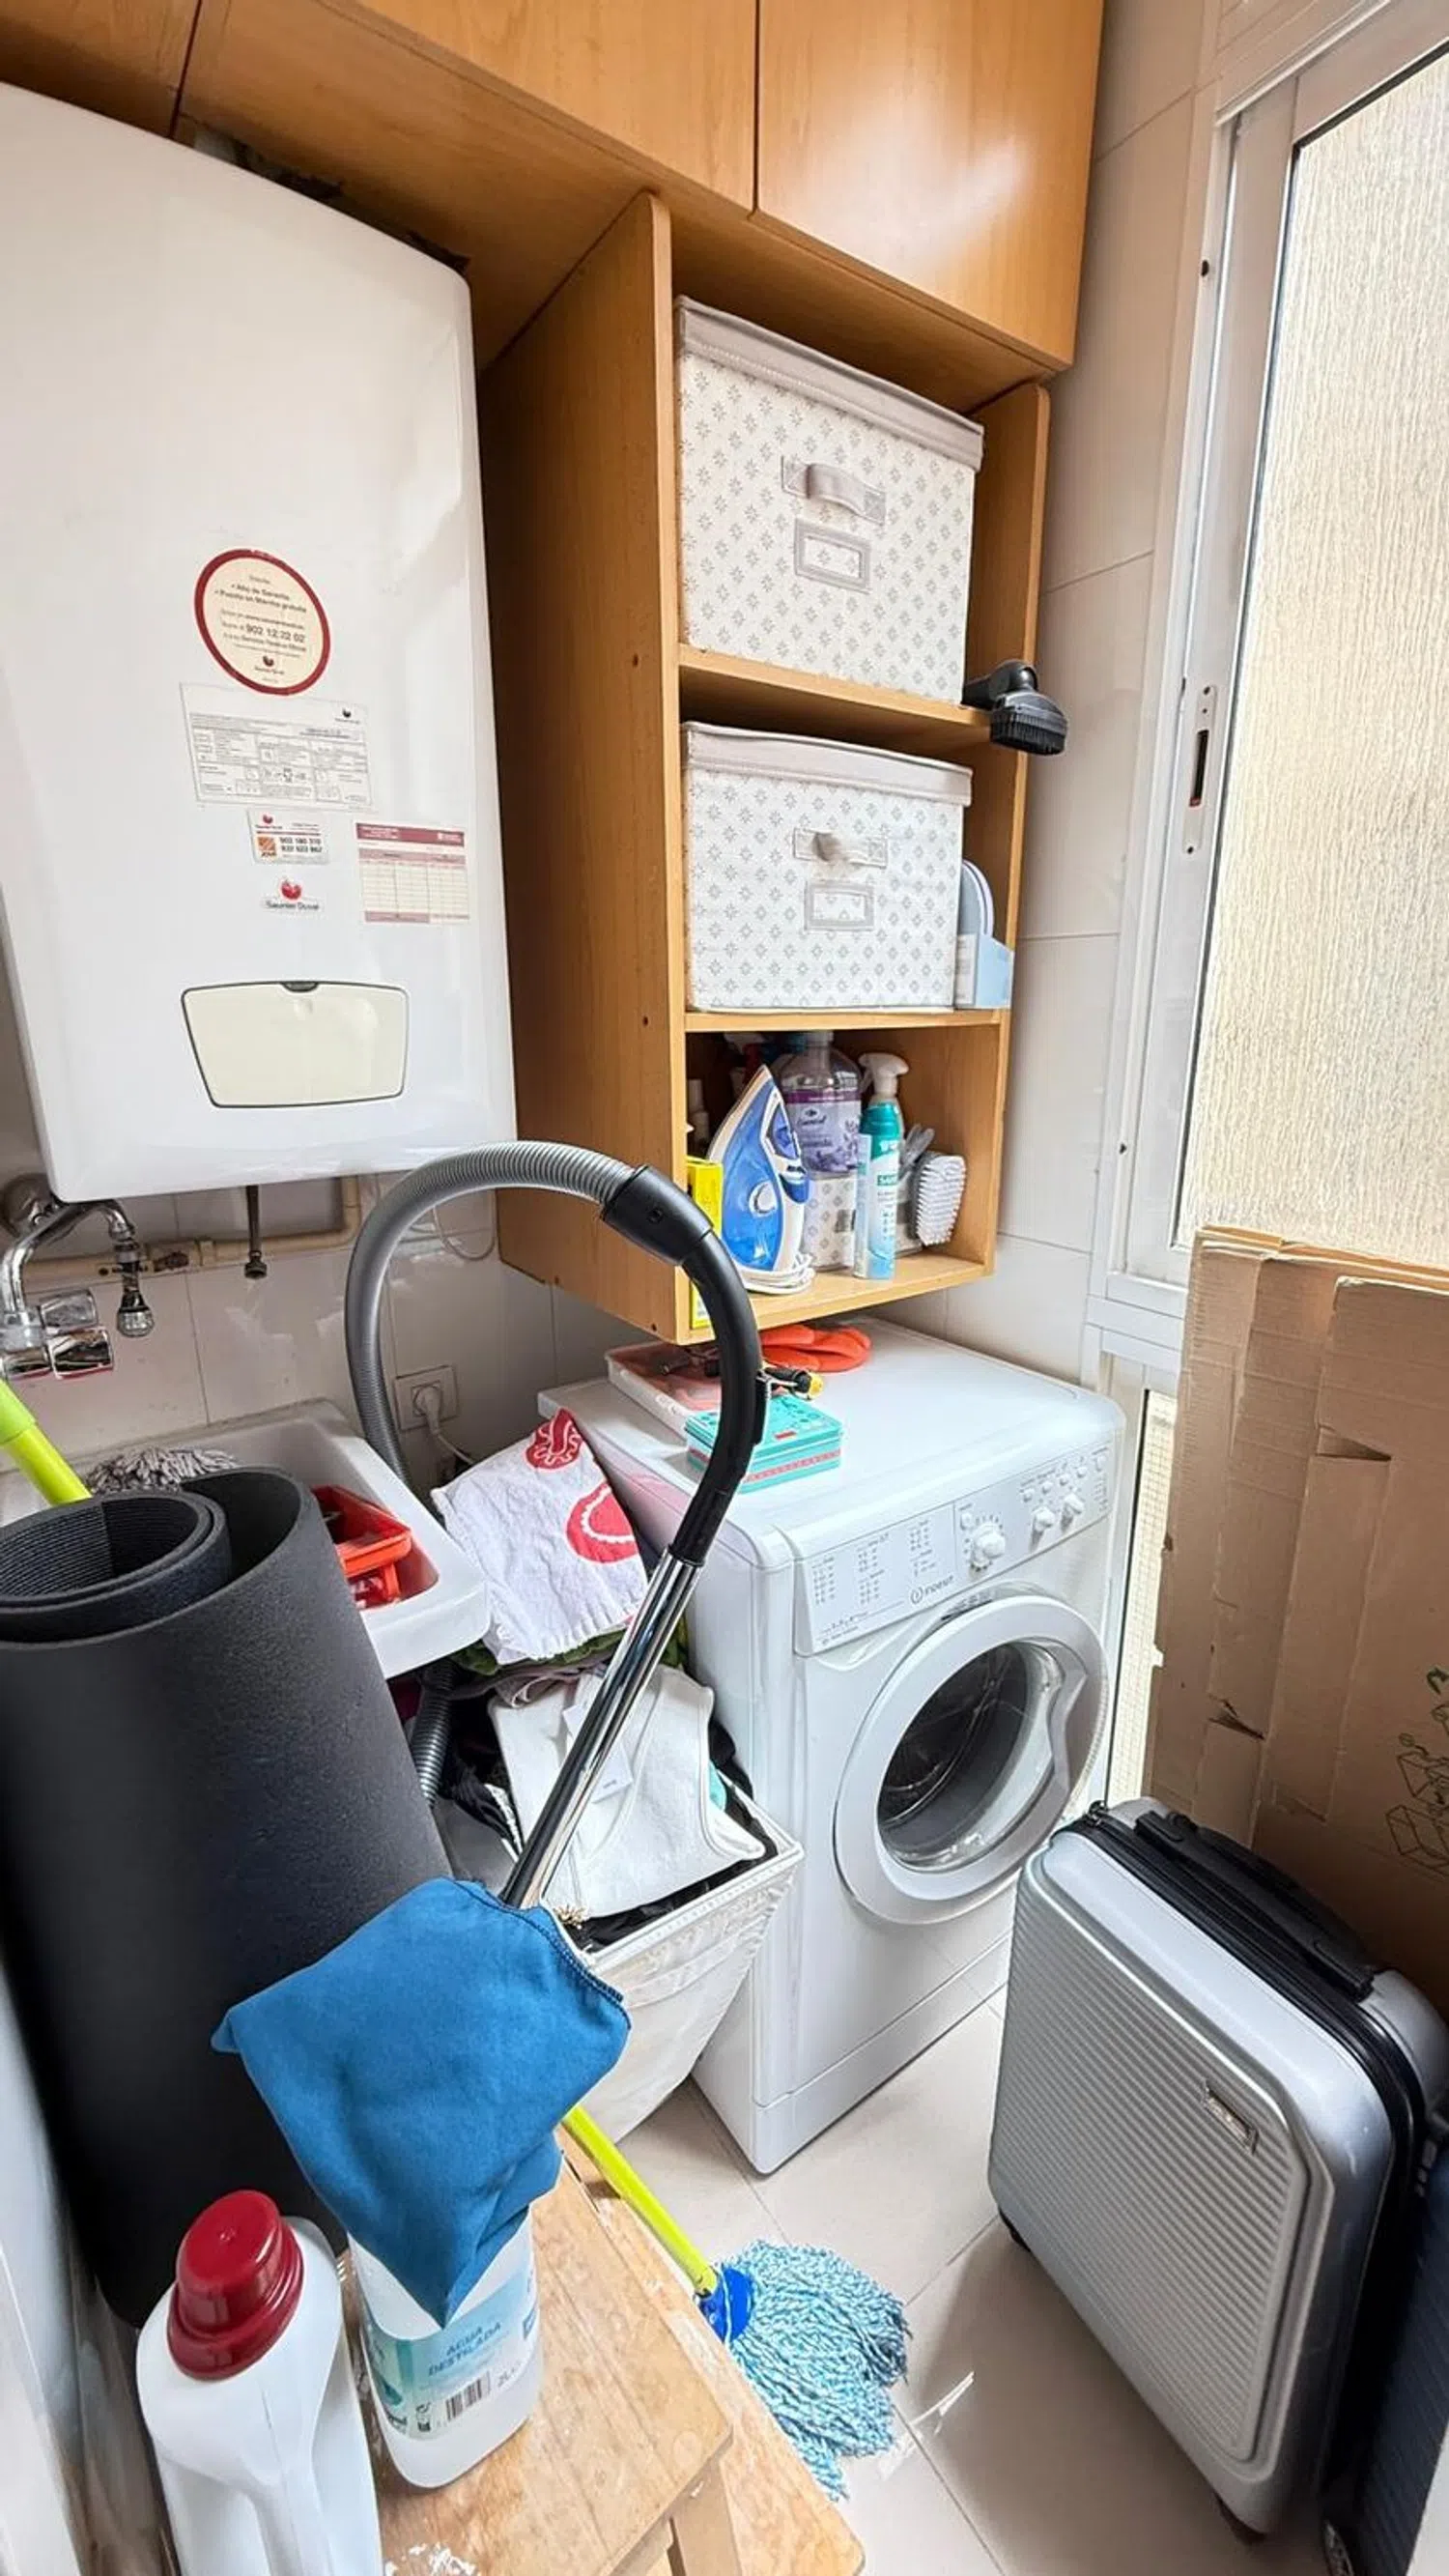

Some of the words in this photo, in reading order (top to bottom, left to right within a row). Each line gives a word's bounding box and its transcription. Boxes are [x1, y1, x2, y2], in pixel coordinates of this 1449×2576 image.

[246, 623, 264, 635] 902
[267, 626, 277, 638] 12
[280, 628, 291, 641] 22
[293, 632, 305, 644] 02
[428, 2322, 501, 2376] DESTILADA
[446, 2326, 483, 2357] AGUA
